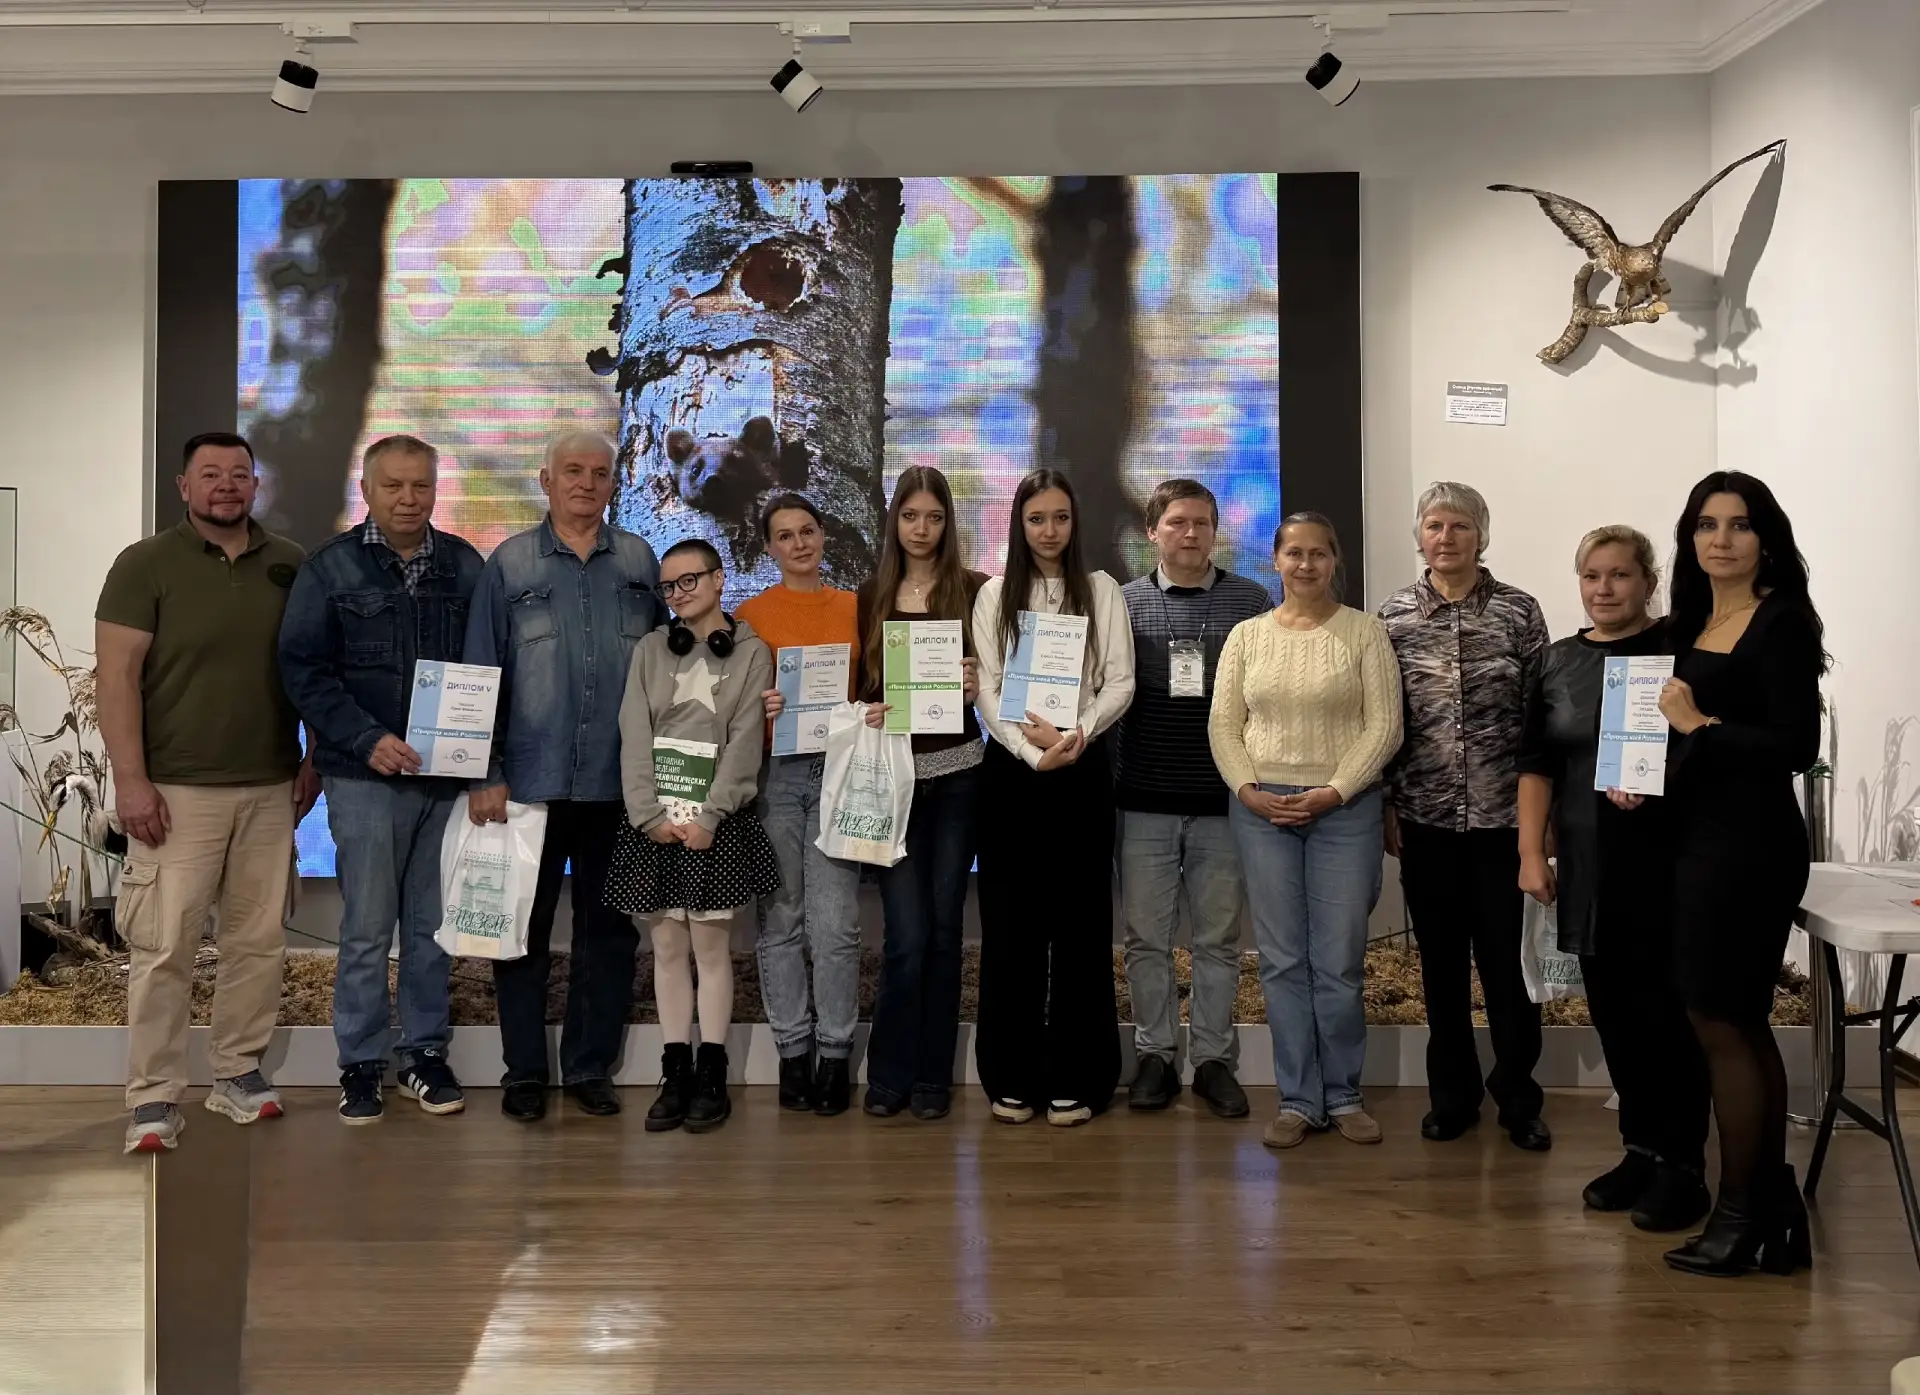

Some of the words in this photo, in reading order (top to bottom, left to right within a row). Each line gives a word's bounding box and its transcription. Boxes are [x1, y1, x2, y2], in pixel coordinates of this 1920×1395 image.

[1037, 629, 1071, 639] ДИПЛОМ
[914, 636, 948, 645] ДИПЛОМ
[804, 660, 836, 669] ДИПЛОМ
[446, 681, 485, 693] ДИПЛОМ
[1629, 676, 1659, 687] ДИПЛОМ
[655, 756, 685, 767] МЕТОДИКА
[654, 763, 681, 774] ВЕДЕНИЯ
[656, 781, 693, 793] АБЛЮДЕНИЙ
[839, 829, 890, 841] ЗАПОВЕДНИК
[456, 926, 501, 939] ЗАПОВЕДНИК
